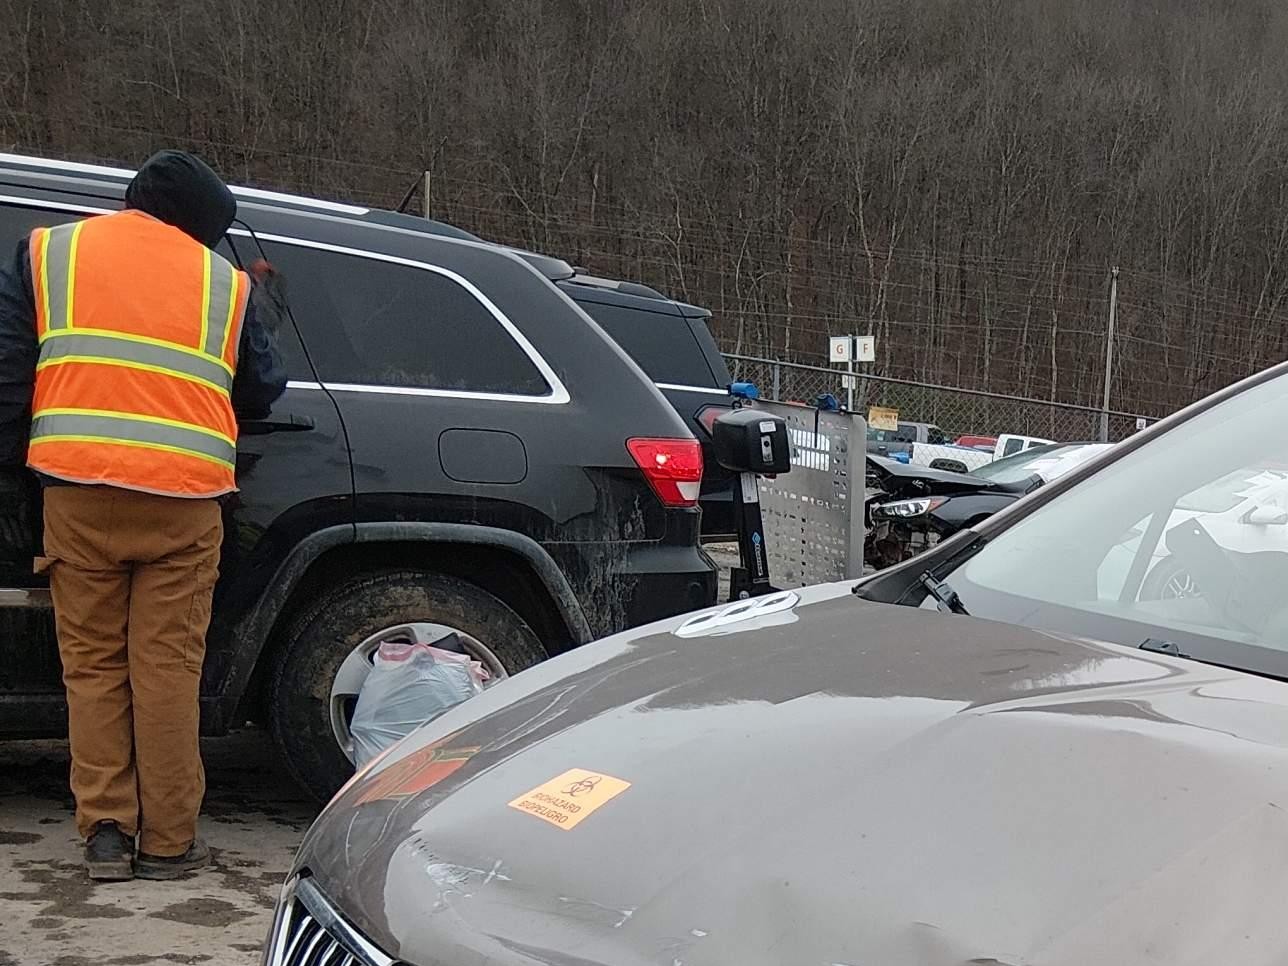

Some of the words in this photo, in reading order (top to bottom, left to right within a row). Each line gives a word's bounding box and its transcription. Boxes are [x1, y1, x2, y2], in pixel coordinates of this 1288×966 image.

[836, 344, 844, 354] G
[863, 343, 869, 354] F
[531, 792, 582, 814] BIOHAZARD
[517, 800, 569, 824] BIOPELIGRO
